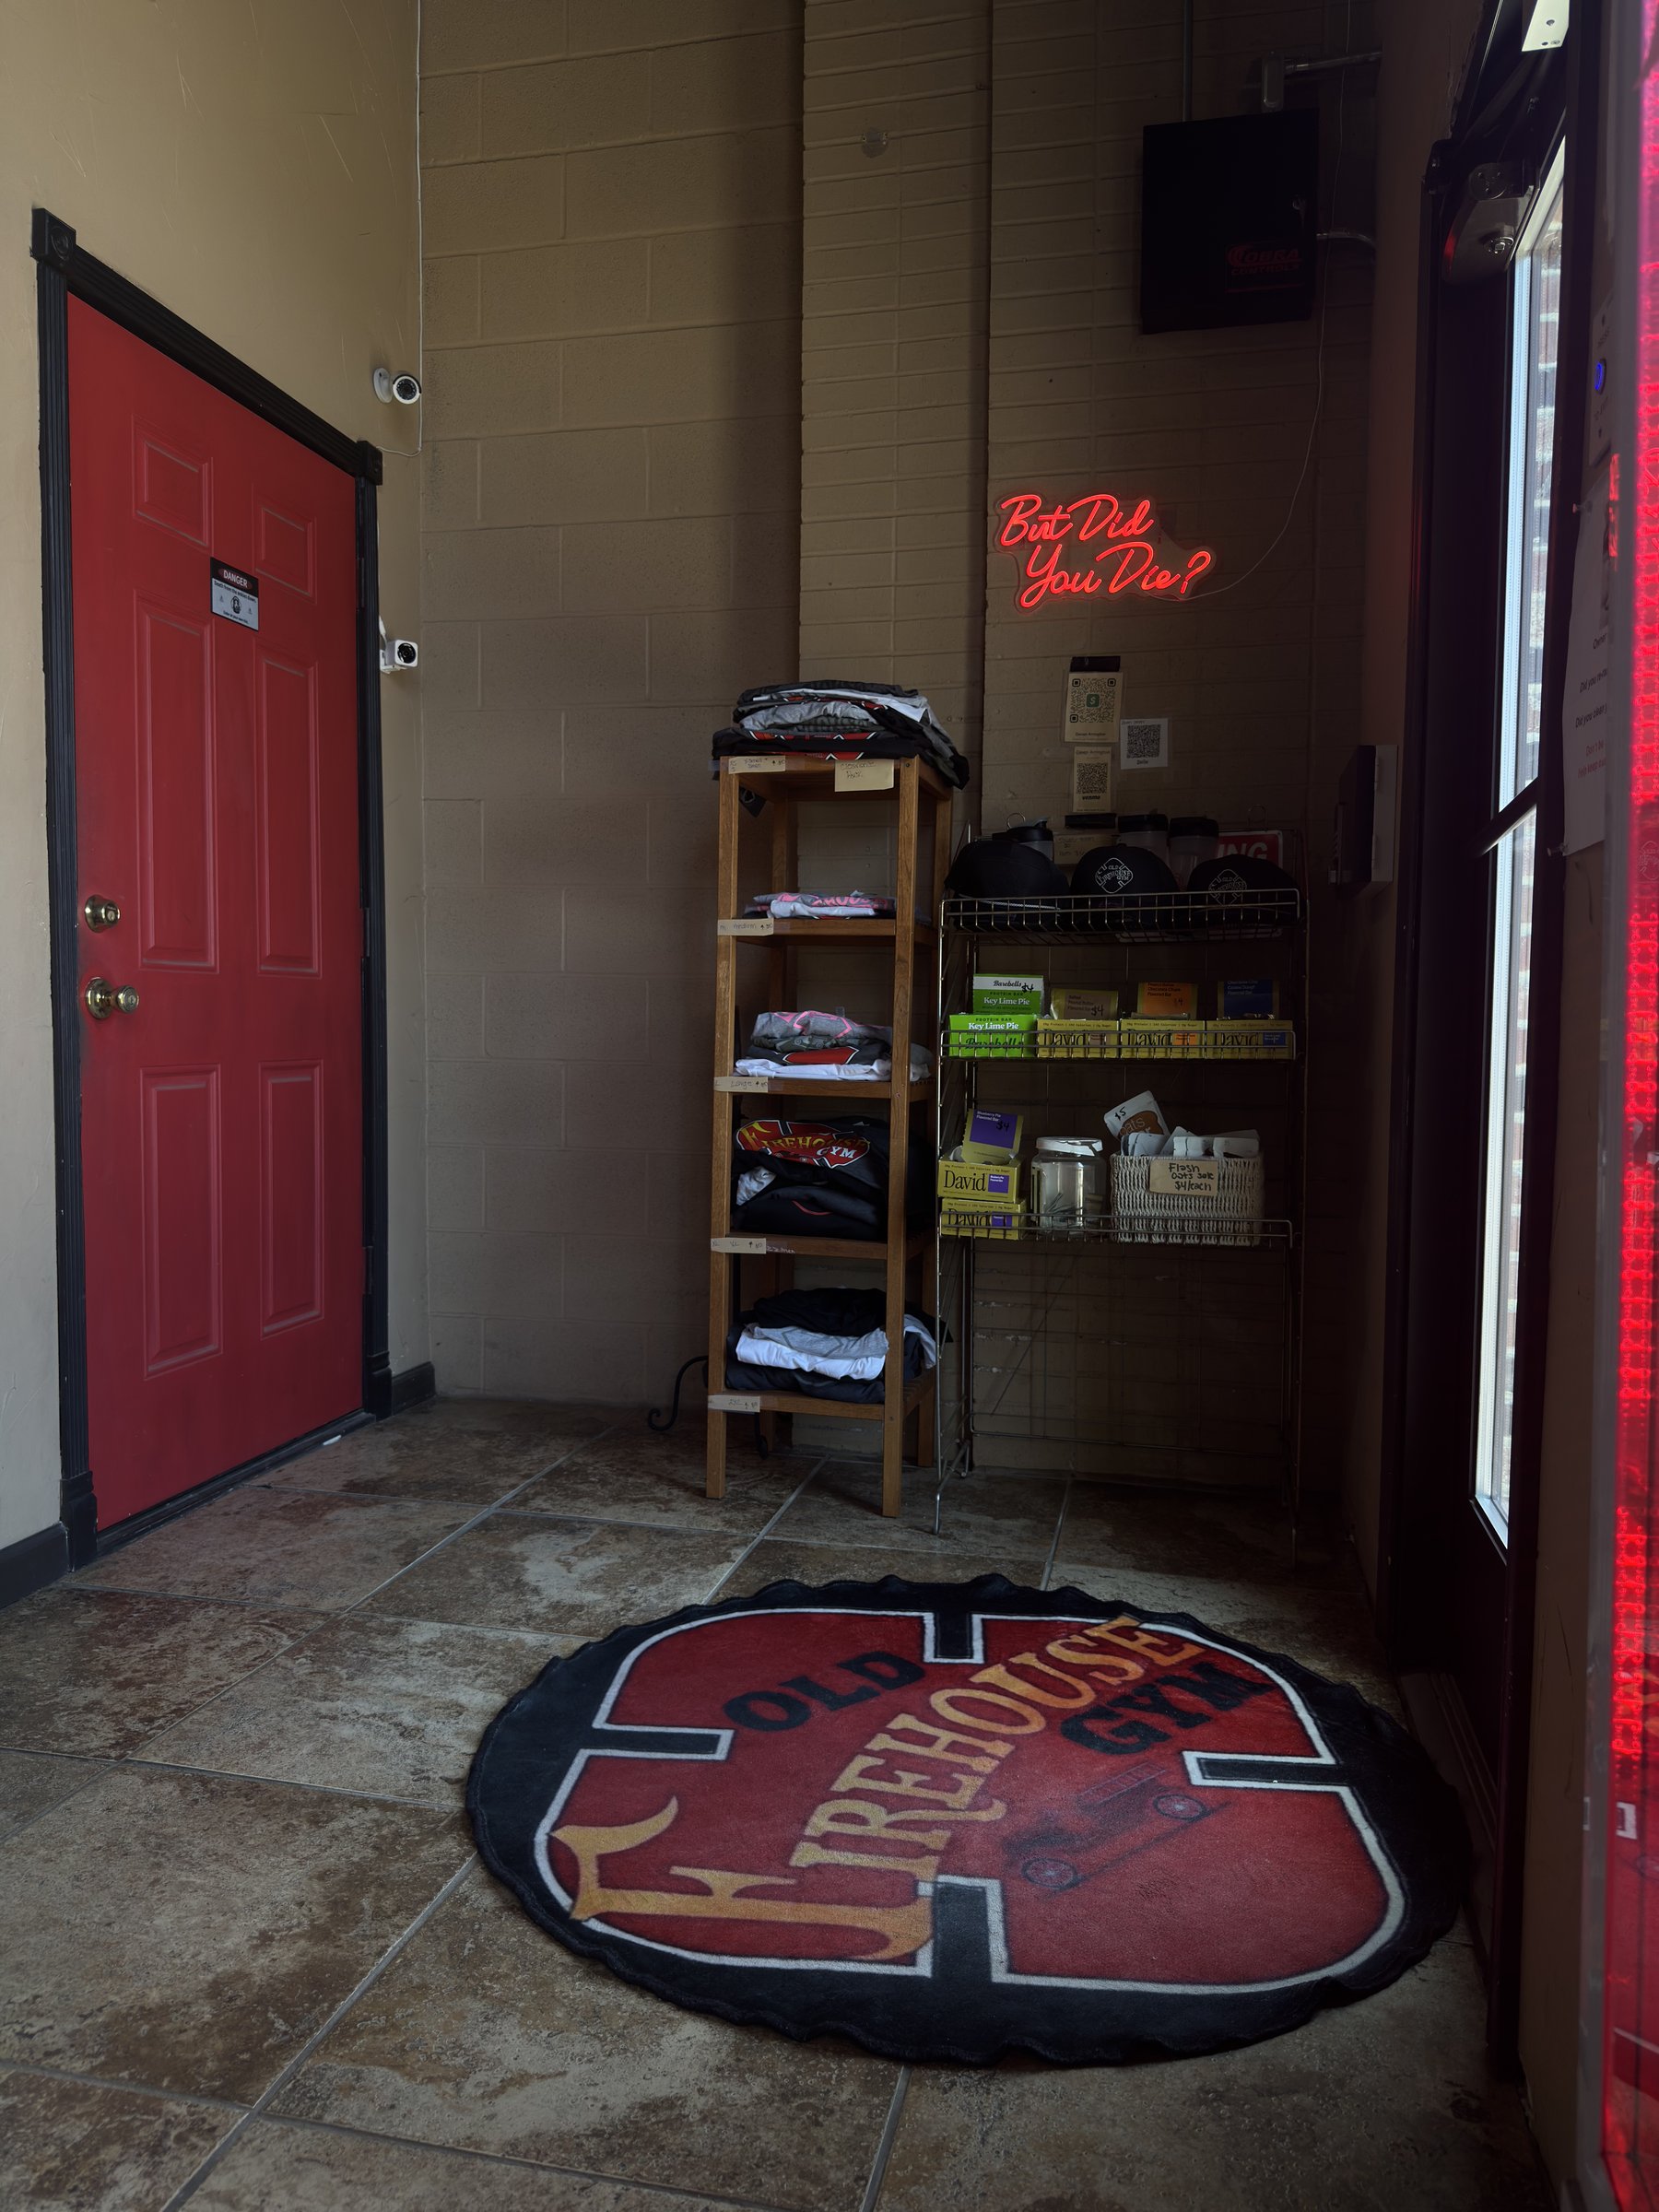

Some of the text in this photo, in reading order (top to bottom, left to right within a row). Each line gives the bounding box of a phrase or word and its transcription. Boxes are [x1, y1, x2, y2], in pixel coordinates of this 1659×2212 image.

[1000, 494, 1154, 547] But Did
[223, 570, 249, 589] DANGER
[1020, 541, 1211, 608] You Die?
[1021, 982, 1034, 994] $4
[983, 997, 1030, 1006] Key Lime Pie
[968, 1022, 1018, 1031] Key Lime Pie
[1043, 1029, 1088, 1046] David
[1127, 1029, 1174, 1046] David
[817, 1146, 857, 1159] GYM
[1169, 1163, 1200, 1172] Flash
[944, 1171, 986, 1192] David
[1175, 1181, 1211, 1191] $4/each
[947, 1208, 990, 1227] David
[724, 1651, 926, 1732] OLD
[1061, 1662, 1272, 1755] GYM
[550, 1615, 1206, 1961] FIREHOUSE
